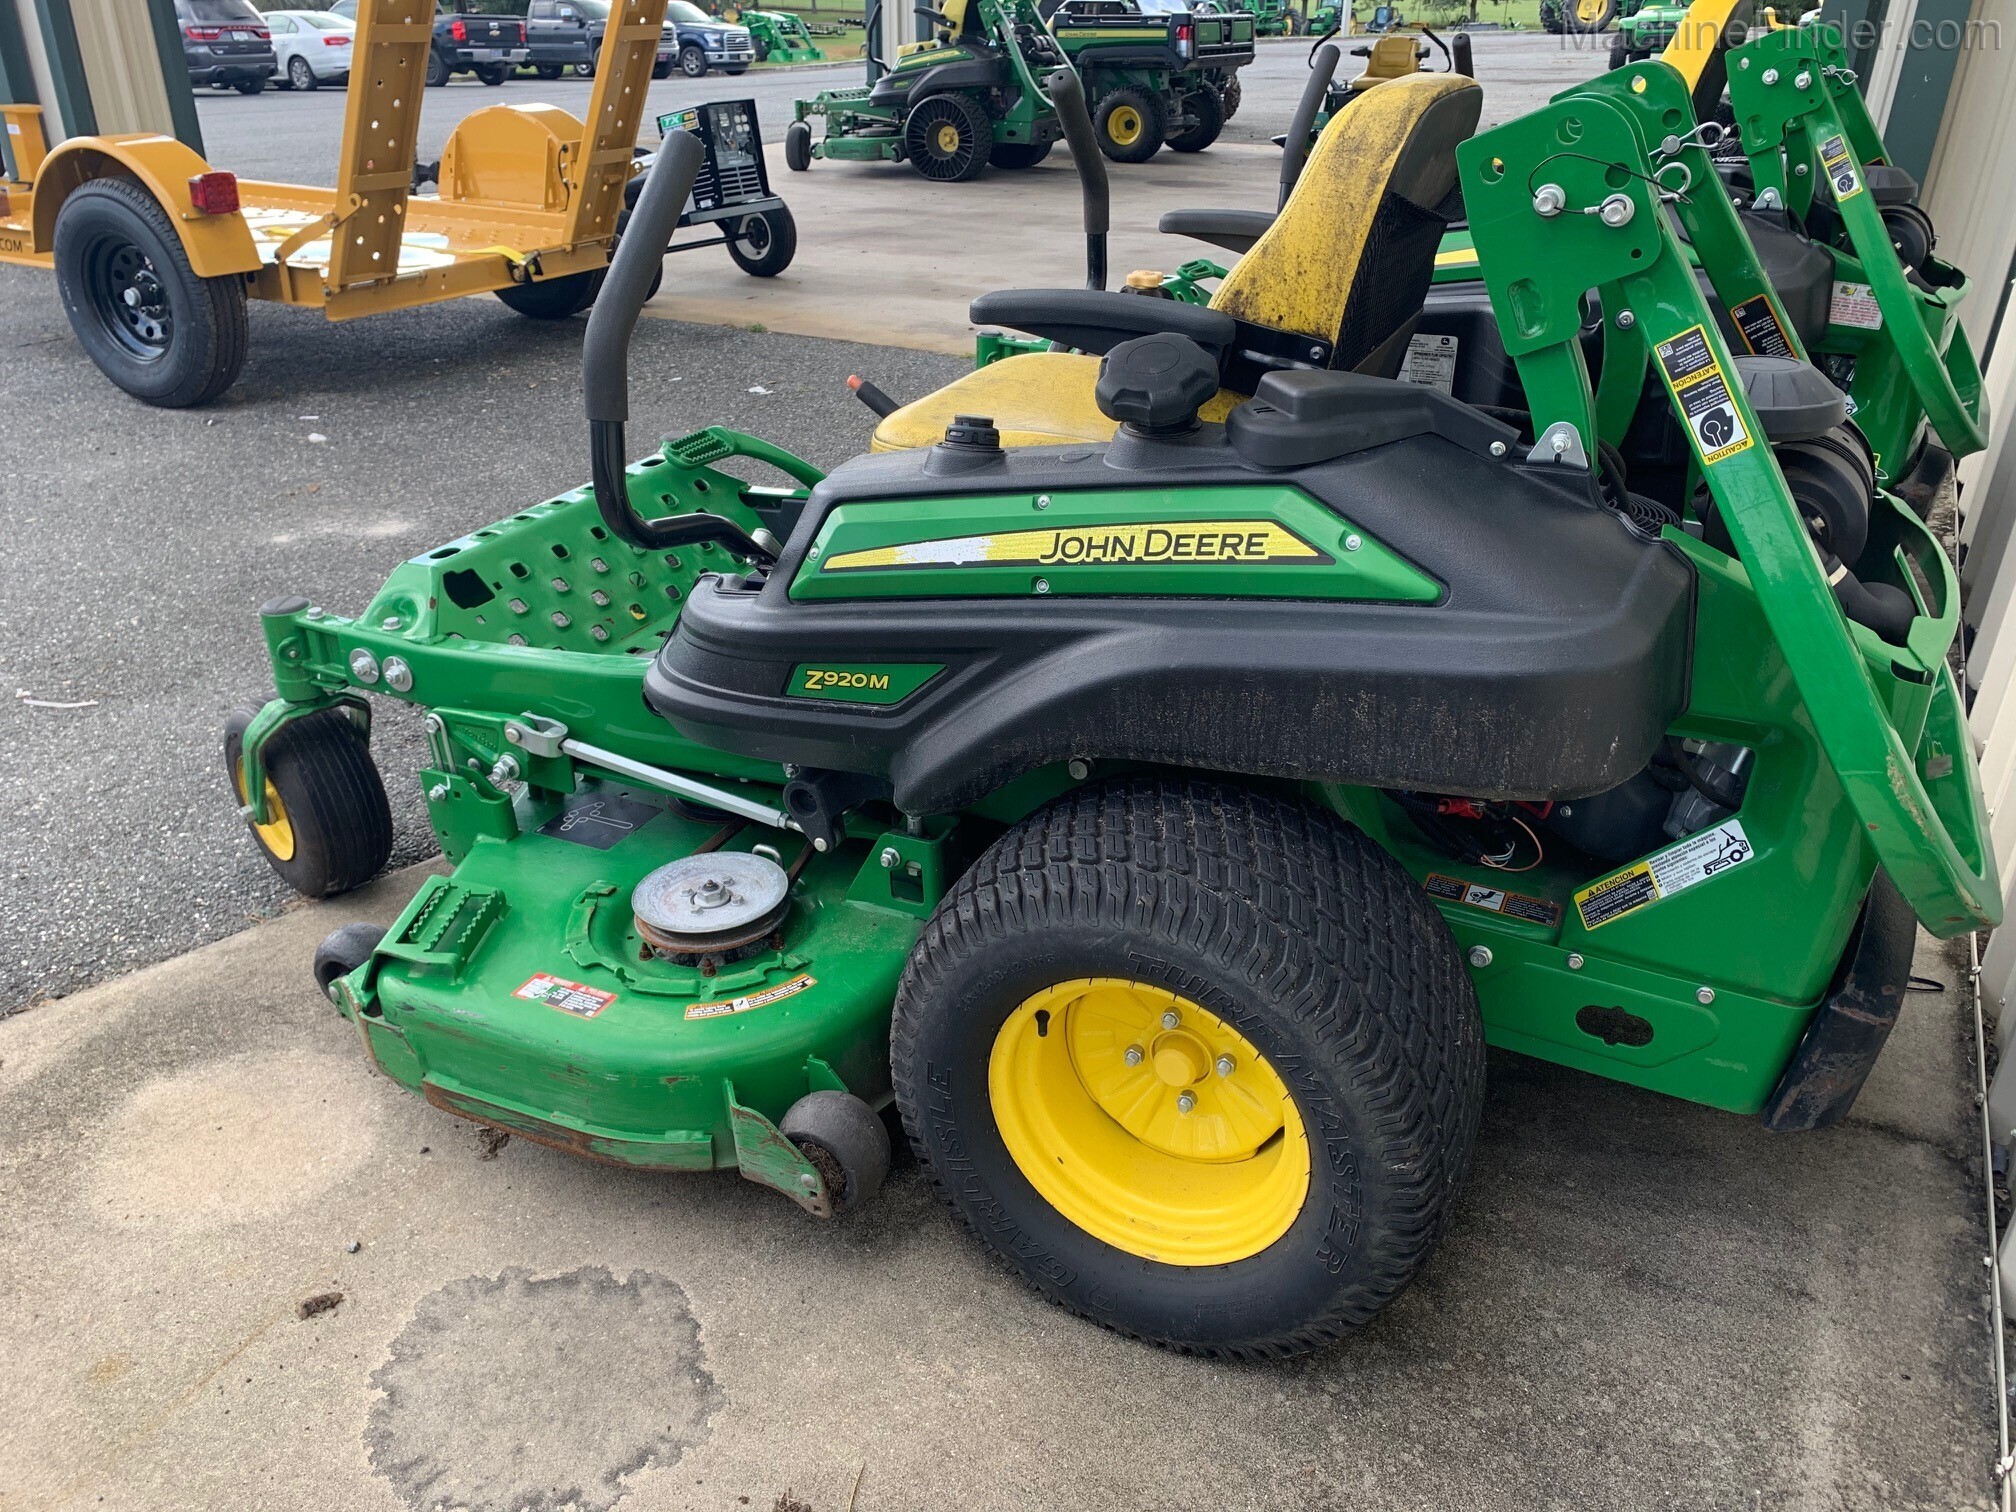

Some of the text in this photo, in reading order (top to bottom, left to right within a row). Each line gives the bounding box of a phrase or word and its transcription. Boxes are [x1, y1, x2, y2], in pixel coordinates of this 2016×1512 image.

[663, 114, 680, 126] TX
[1672, 368, 1710, 389] ATENCIÓN
[1708, 443, 1742, 463] CAUTION
[1040, 529, 1270, 560] JOHN DEERE
[804, 670, 890, 690] Z920M
[1596, 870, 1635, 893] ATENCION
[1127, 951, 1363, 1275] TURF MASTER
[926, 1059, 1078, 1288] CARLISLE
